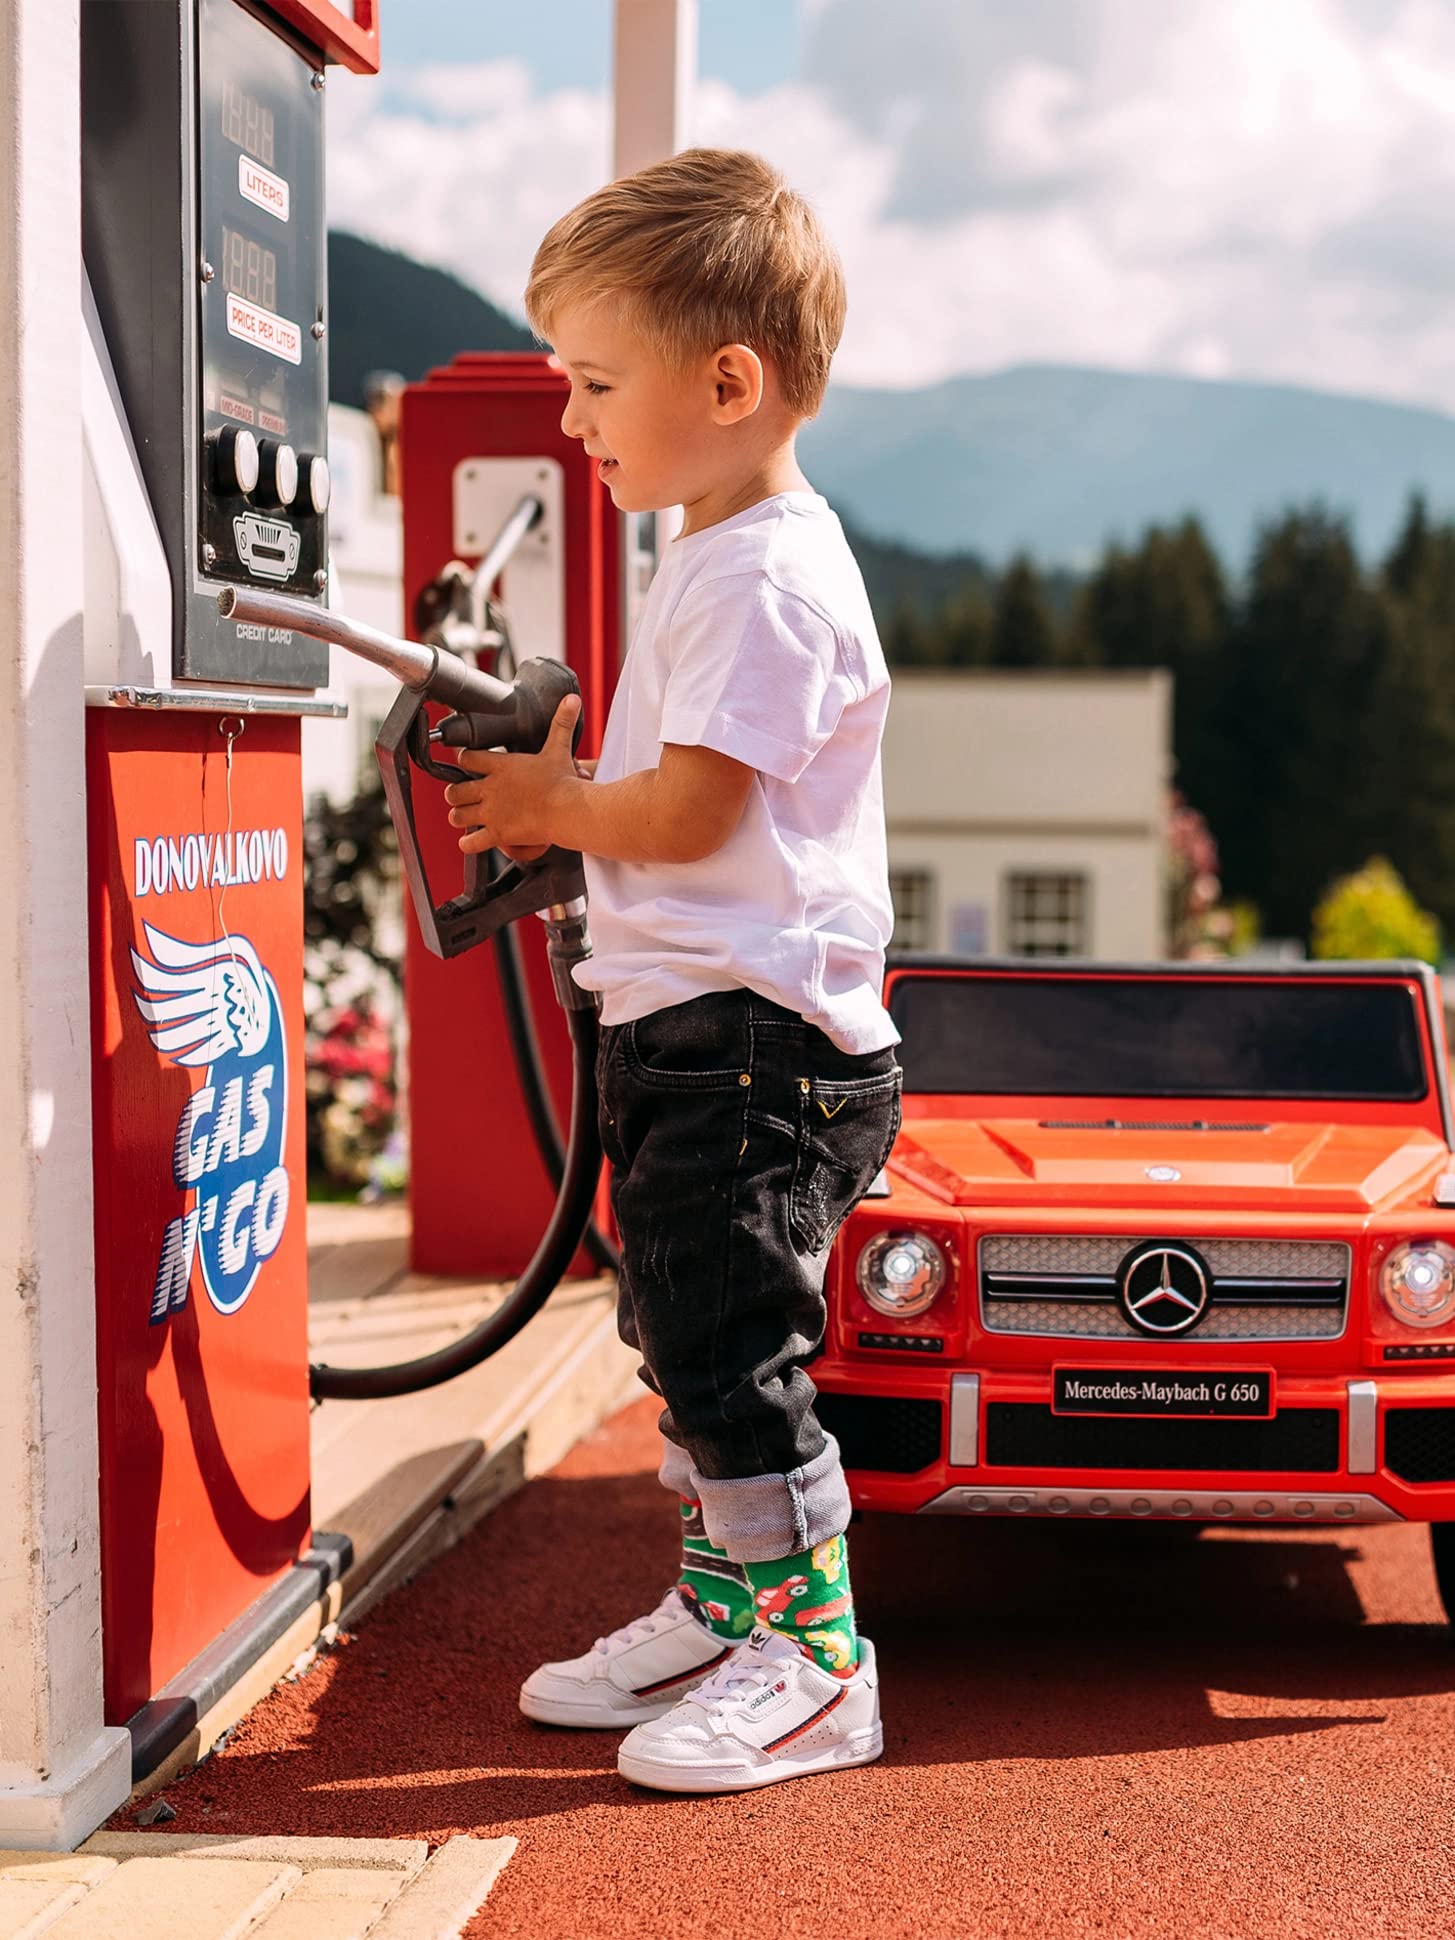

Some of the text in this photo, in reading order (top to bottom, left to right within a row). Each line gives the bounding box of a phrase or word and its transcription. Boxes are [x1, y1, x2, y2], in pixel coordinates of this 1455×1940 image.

[246, 170, 284, 208] LITERS
[232, 306, 297, 353] PRICE PER LITER
[236, 623, 293, 646] CREDIT CARD
[134, 827, 289, 898] DONOVALKOVO
[172, 1064, 275, 1189] GAS
[1064, 1380, 1260, 1404] Mercedes-Maybach G 650
